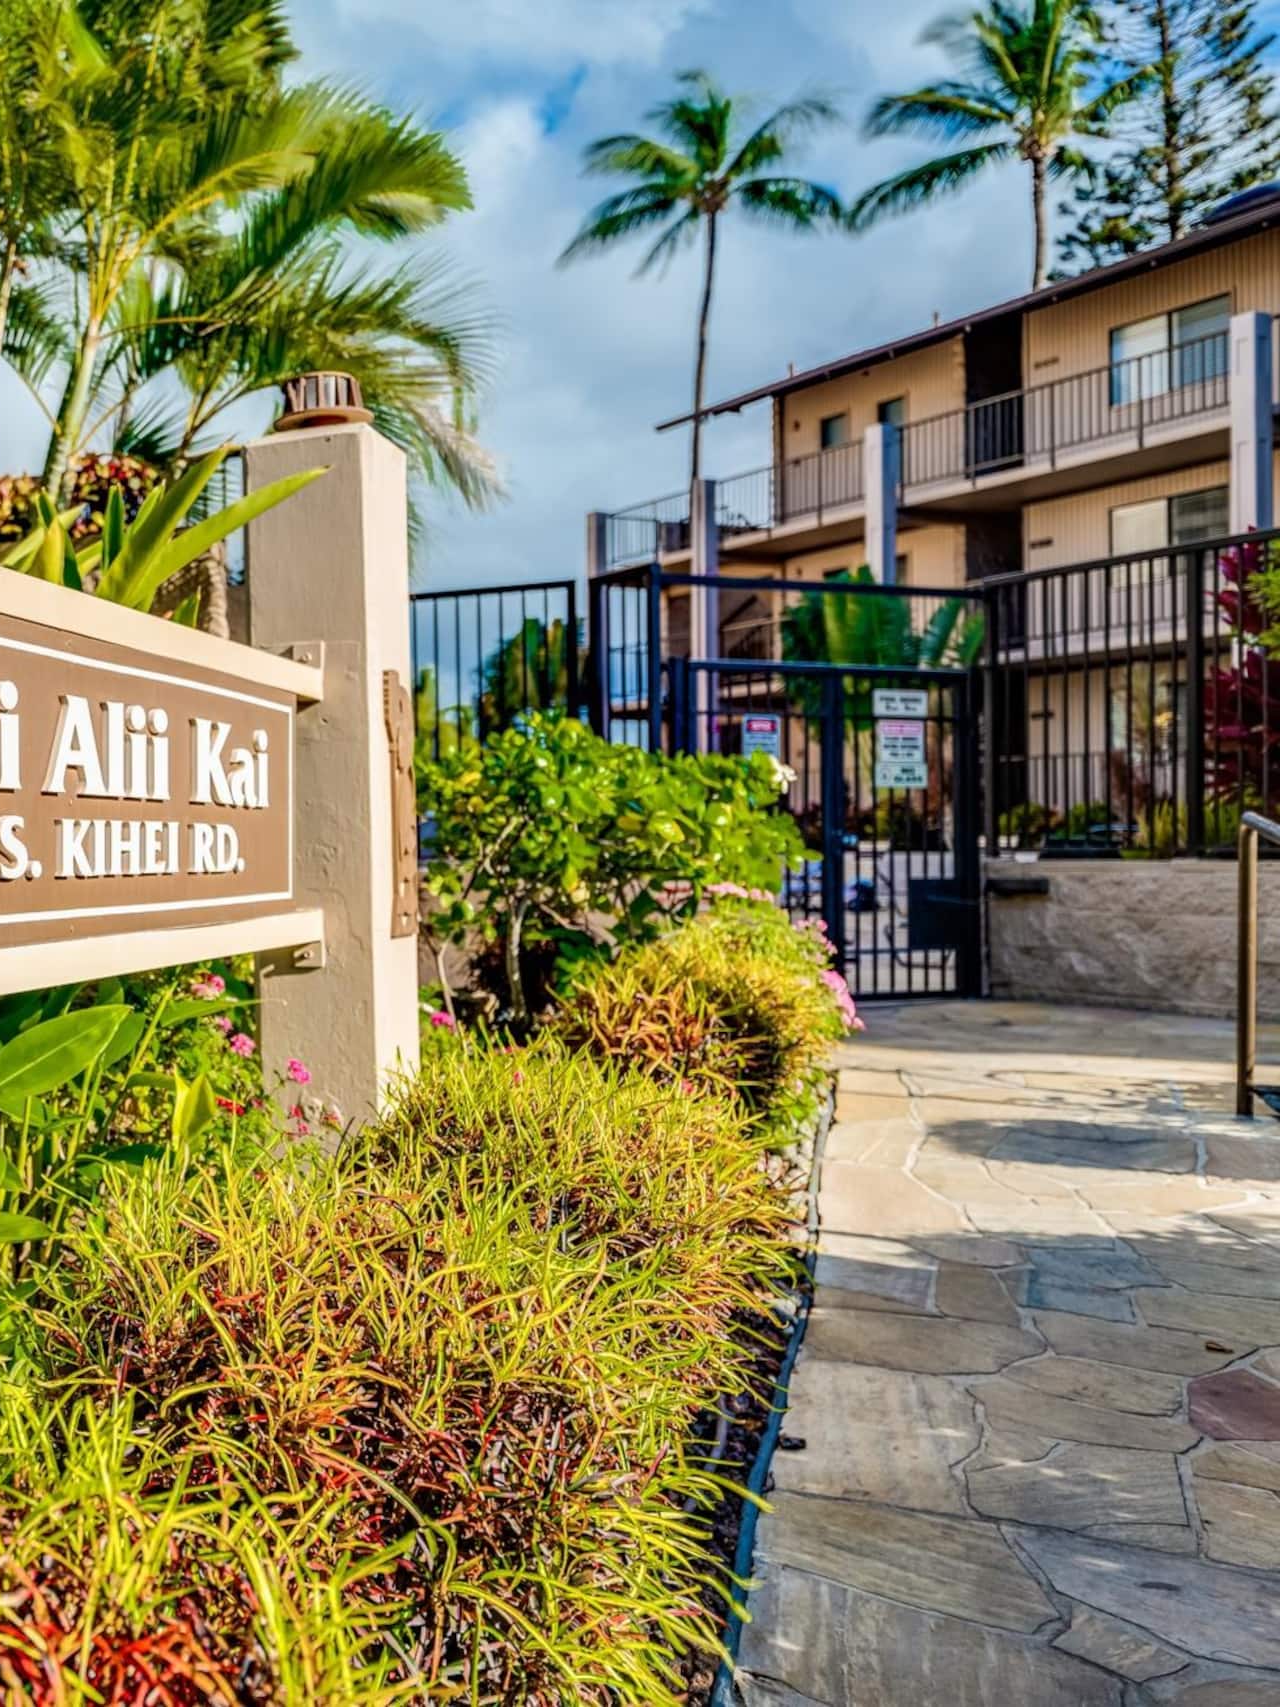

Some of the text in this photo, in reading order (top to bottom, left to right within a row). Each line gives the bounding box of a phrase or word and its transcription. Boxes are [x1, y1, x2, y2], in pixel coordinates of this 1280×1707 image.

[41, 694, 171, 803] Alii
[189, 718, 269, 809] Kai
[54, 818, 179, 880] KIHEI
[187, 823, 245, 875] RD.
